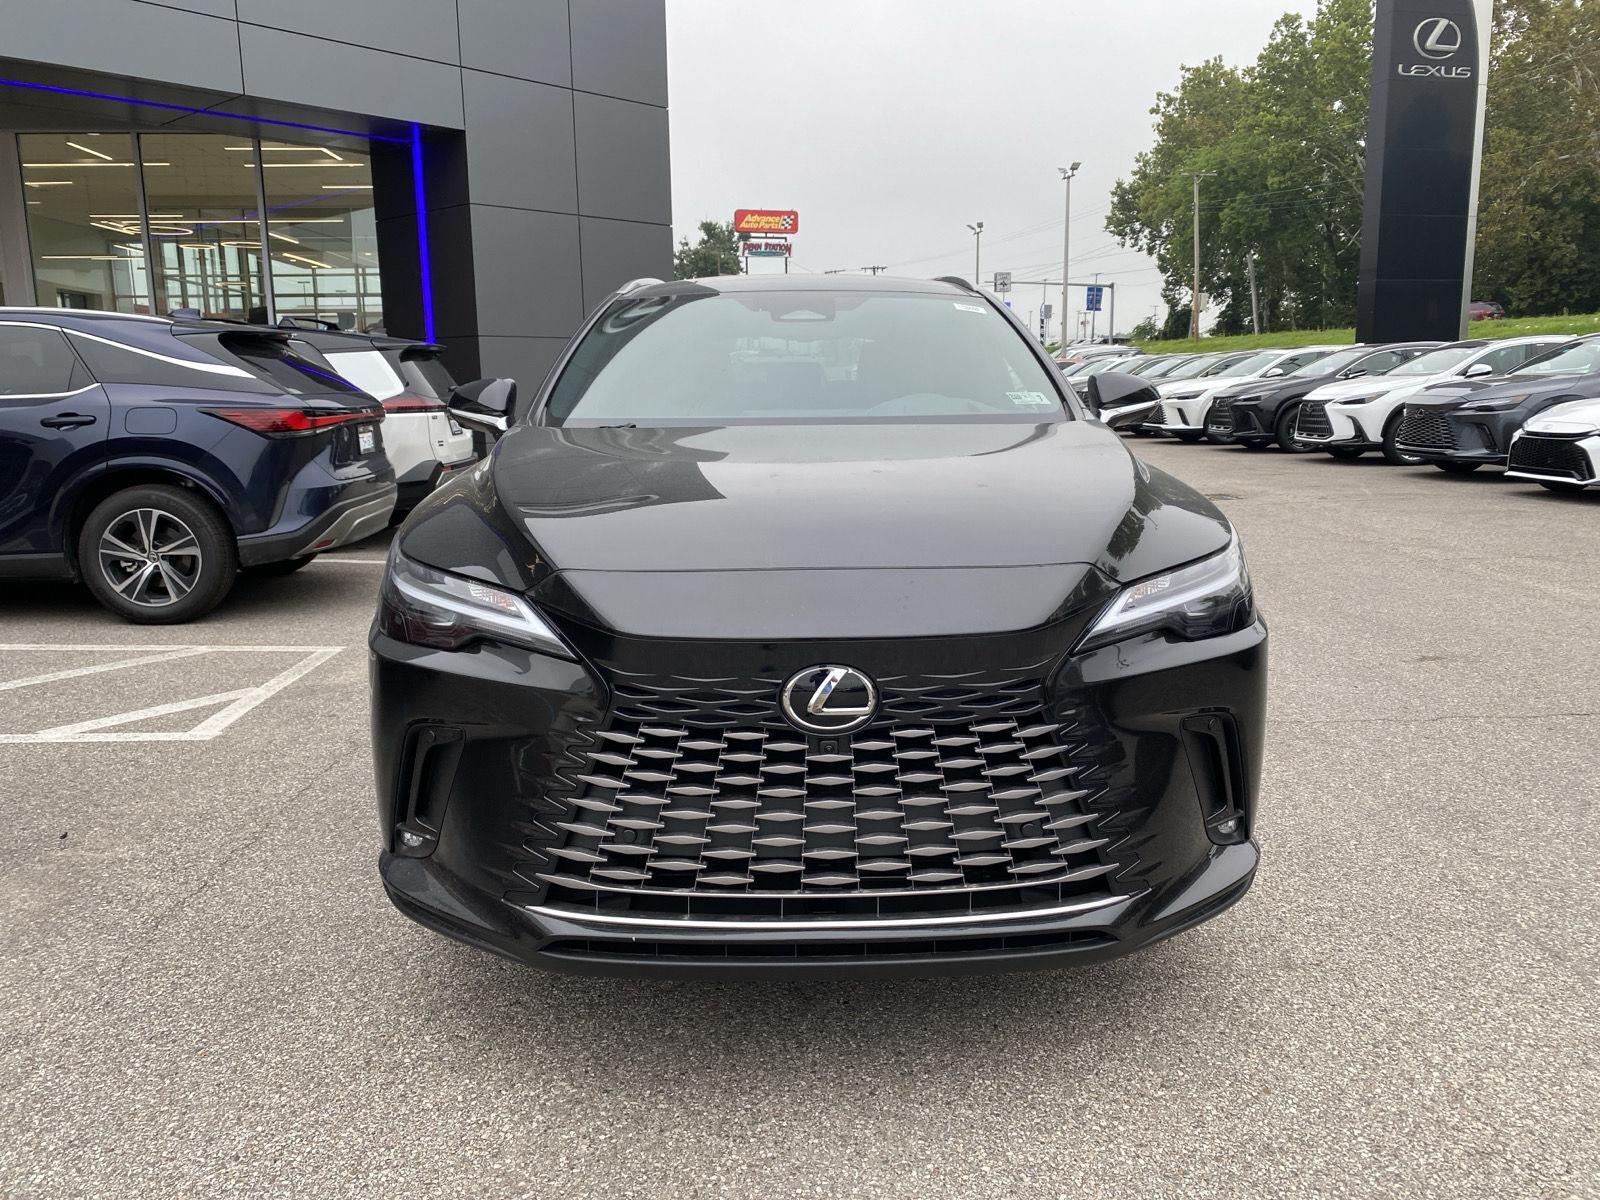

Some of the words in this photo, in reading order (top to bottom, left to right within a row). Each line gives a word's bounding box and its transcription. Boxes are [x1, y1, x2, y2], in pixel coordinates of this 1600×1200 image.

[1398, 64, 1471, 78] LEXUS
[740, 220, 759, 228] Auto
[744, 214, 781, 223] Advance
[764, 242, 792, 256] STATION
